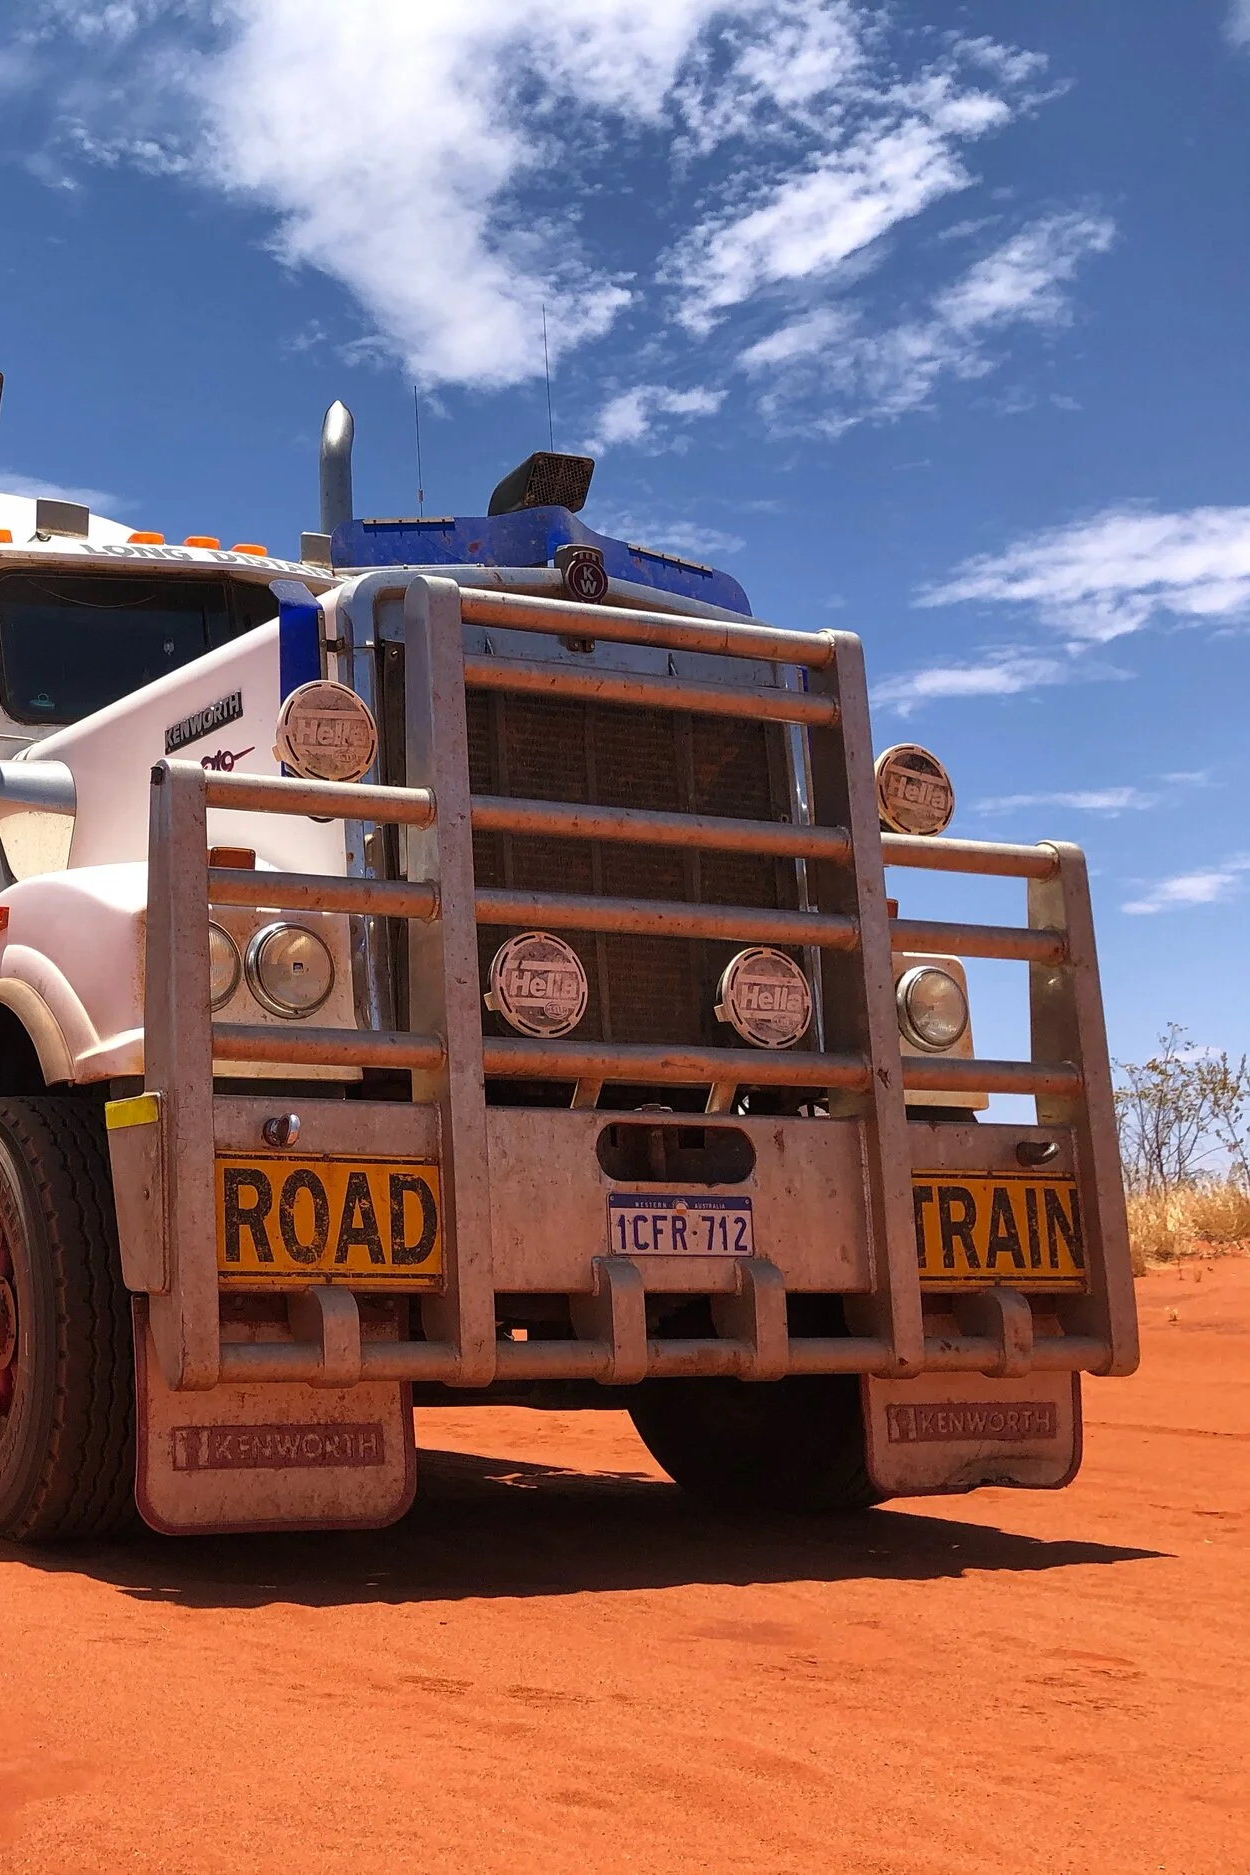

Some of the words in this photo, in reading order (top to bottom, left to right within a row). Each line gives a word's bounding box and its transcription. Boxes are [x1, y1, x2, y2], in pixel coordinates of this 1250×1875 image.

[81, 544, 194, 561] LONG
[207, 551, 350, 580] DISTAN
[165, 691, 240, 749] KENWORTH
[510, 970, 577, 998] Hella
[740, 984, 802, 1013] Hella
[223, 1167, 438, 1265] ROAD
[912, 1185, 1085, 1269] TRAIN
[921, 1410, 1051, 1434] KENWORTH
[214, 1433, 378, 1461] KENWORTH
